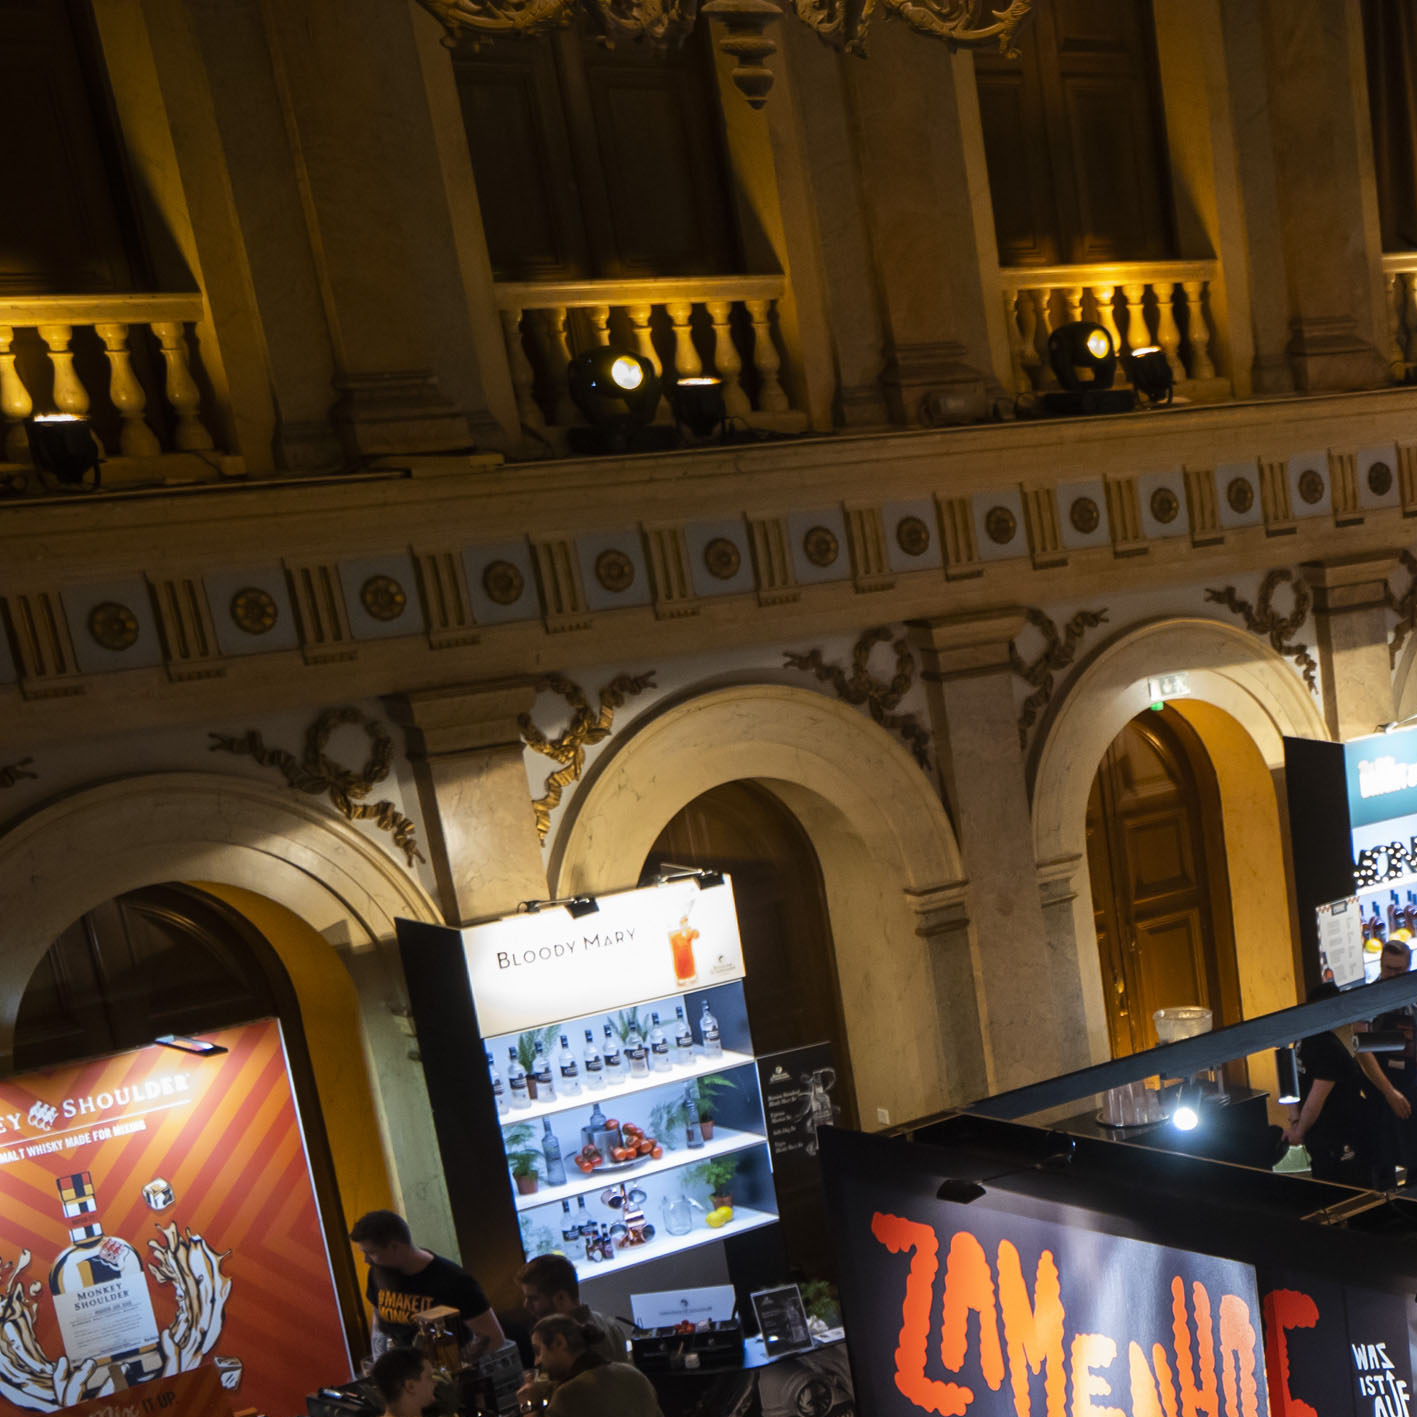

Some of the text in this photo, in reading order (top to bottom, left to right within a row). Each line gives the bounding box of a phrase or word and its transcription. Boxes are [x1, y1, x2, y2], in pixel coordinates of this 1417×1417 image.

[496, 928, 637, 970] BLOODY MARY
[62, 1074, 190, 1118] SHOULDER
[26, 1140, 63, 1157] WHISKY
[64, 1133, 92, 1148] MADE
[92, 1126, 112, 1142] FOR
[73, 1290, 130, 1311] SHOULDER
[77, 1282, 122, 1301] MONKEY
[1359, 1374, 1386, 1397] IST
[140, 1398, 155, 1414] IT
[158, 1391, 177, 1409] UP
